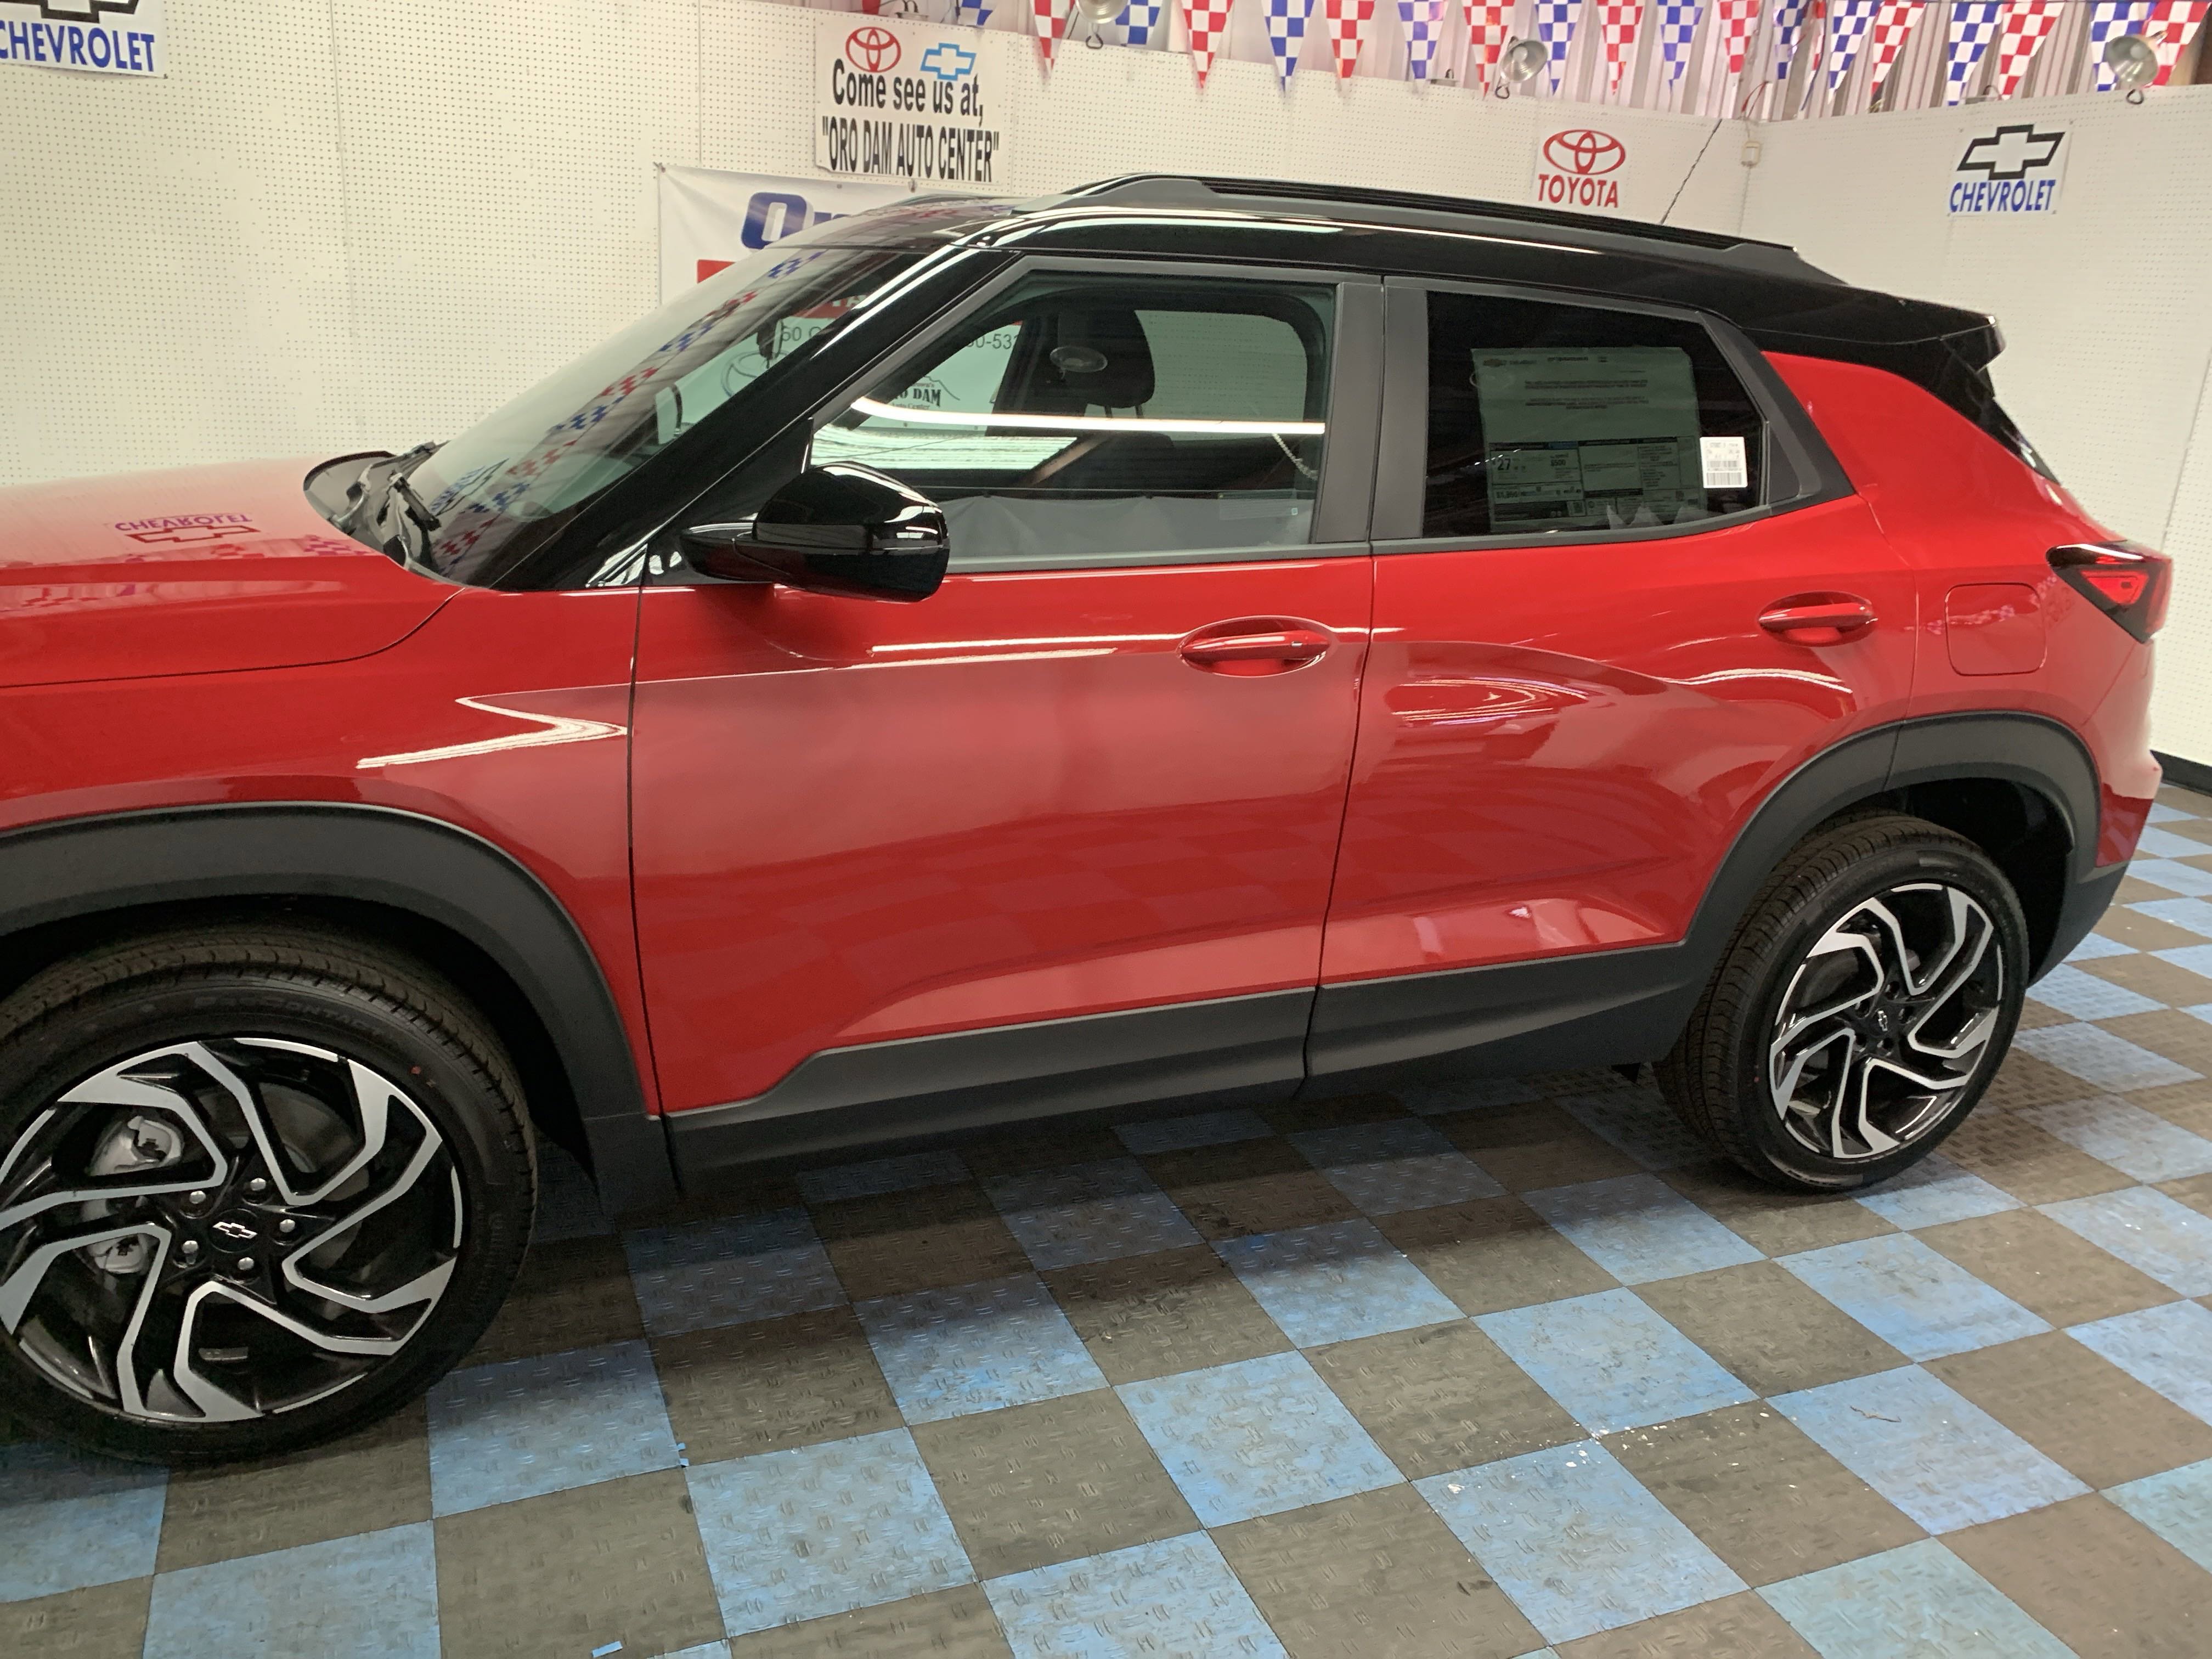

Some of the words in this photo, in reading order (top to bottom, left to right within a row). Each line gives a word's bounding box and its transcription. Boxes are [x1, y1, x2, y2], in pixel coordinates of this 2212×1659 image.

[832, 58, 887, 109] Come
[893, 76, 926, 112] see
[933, 80, 953, 114] us
[960, 73, 984, 127] at,
[822, 115, 858, 173] "ORO
[863, 119, 892, 175] DAM
[896, 122, 933, 179] AUTO
[938, 126, 1000, 183] CENTER"
[1538, 173, 1618, 208] TOYOTA
[1949, 179, 2056, 213] CHEVROLET
[967, 333, 1018, 350] 0-53
[912, 388, 941, 408] DAM
[1497, 458, 1511, 471] 27
